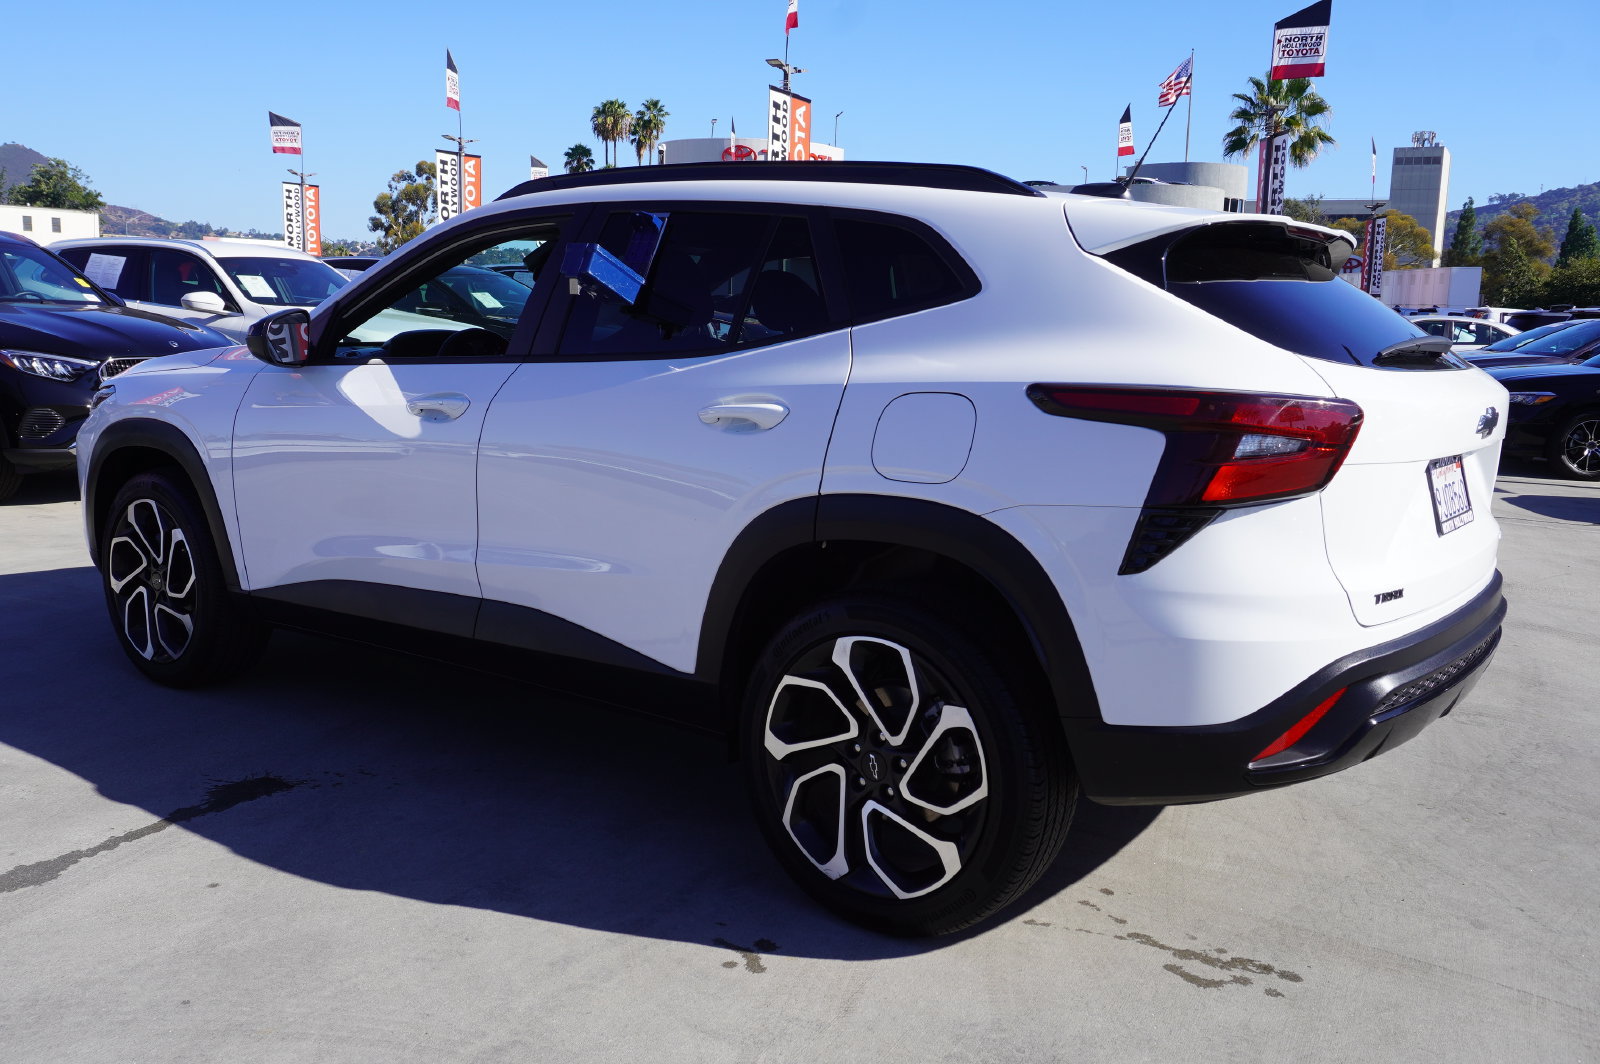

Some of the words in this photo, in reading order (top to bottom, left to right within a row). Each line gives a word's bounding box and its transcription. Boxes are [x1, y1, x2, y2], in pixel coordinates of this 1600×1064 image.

[1281, 41, 1321, 49] HOLLYWOOD
[1281, 48, 1320, 57] TOYOTA
[1284, 35, 1323, 43] NORTH
[794, 105, 807, 161] OTA
[440, 158, 450, 221] ORTH
[450, 158, 458, 214] LYWOOD
[465, 159, 476, 212] YOTA
[285, 188, 294, 248] NORTH
[293, 187, 302, 250] HOLLYWOOD
[306, 188, 317, 250] TOYOTA
[1372, 223, 1381, 287] NORTH
